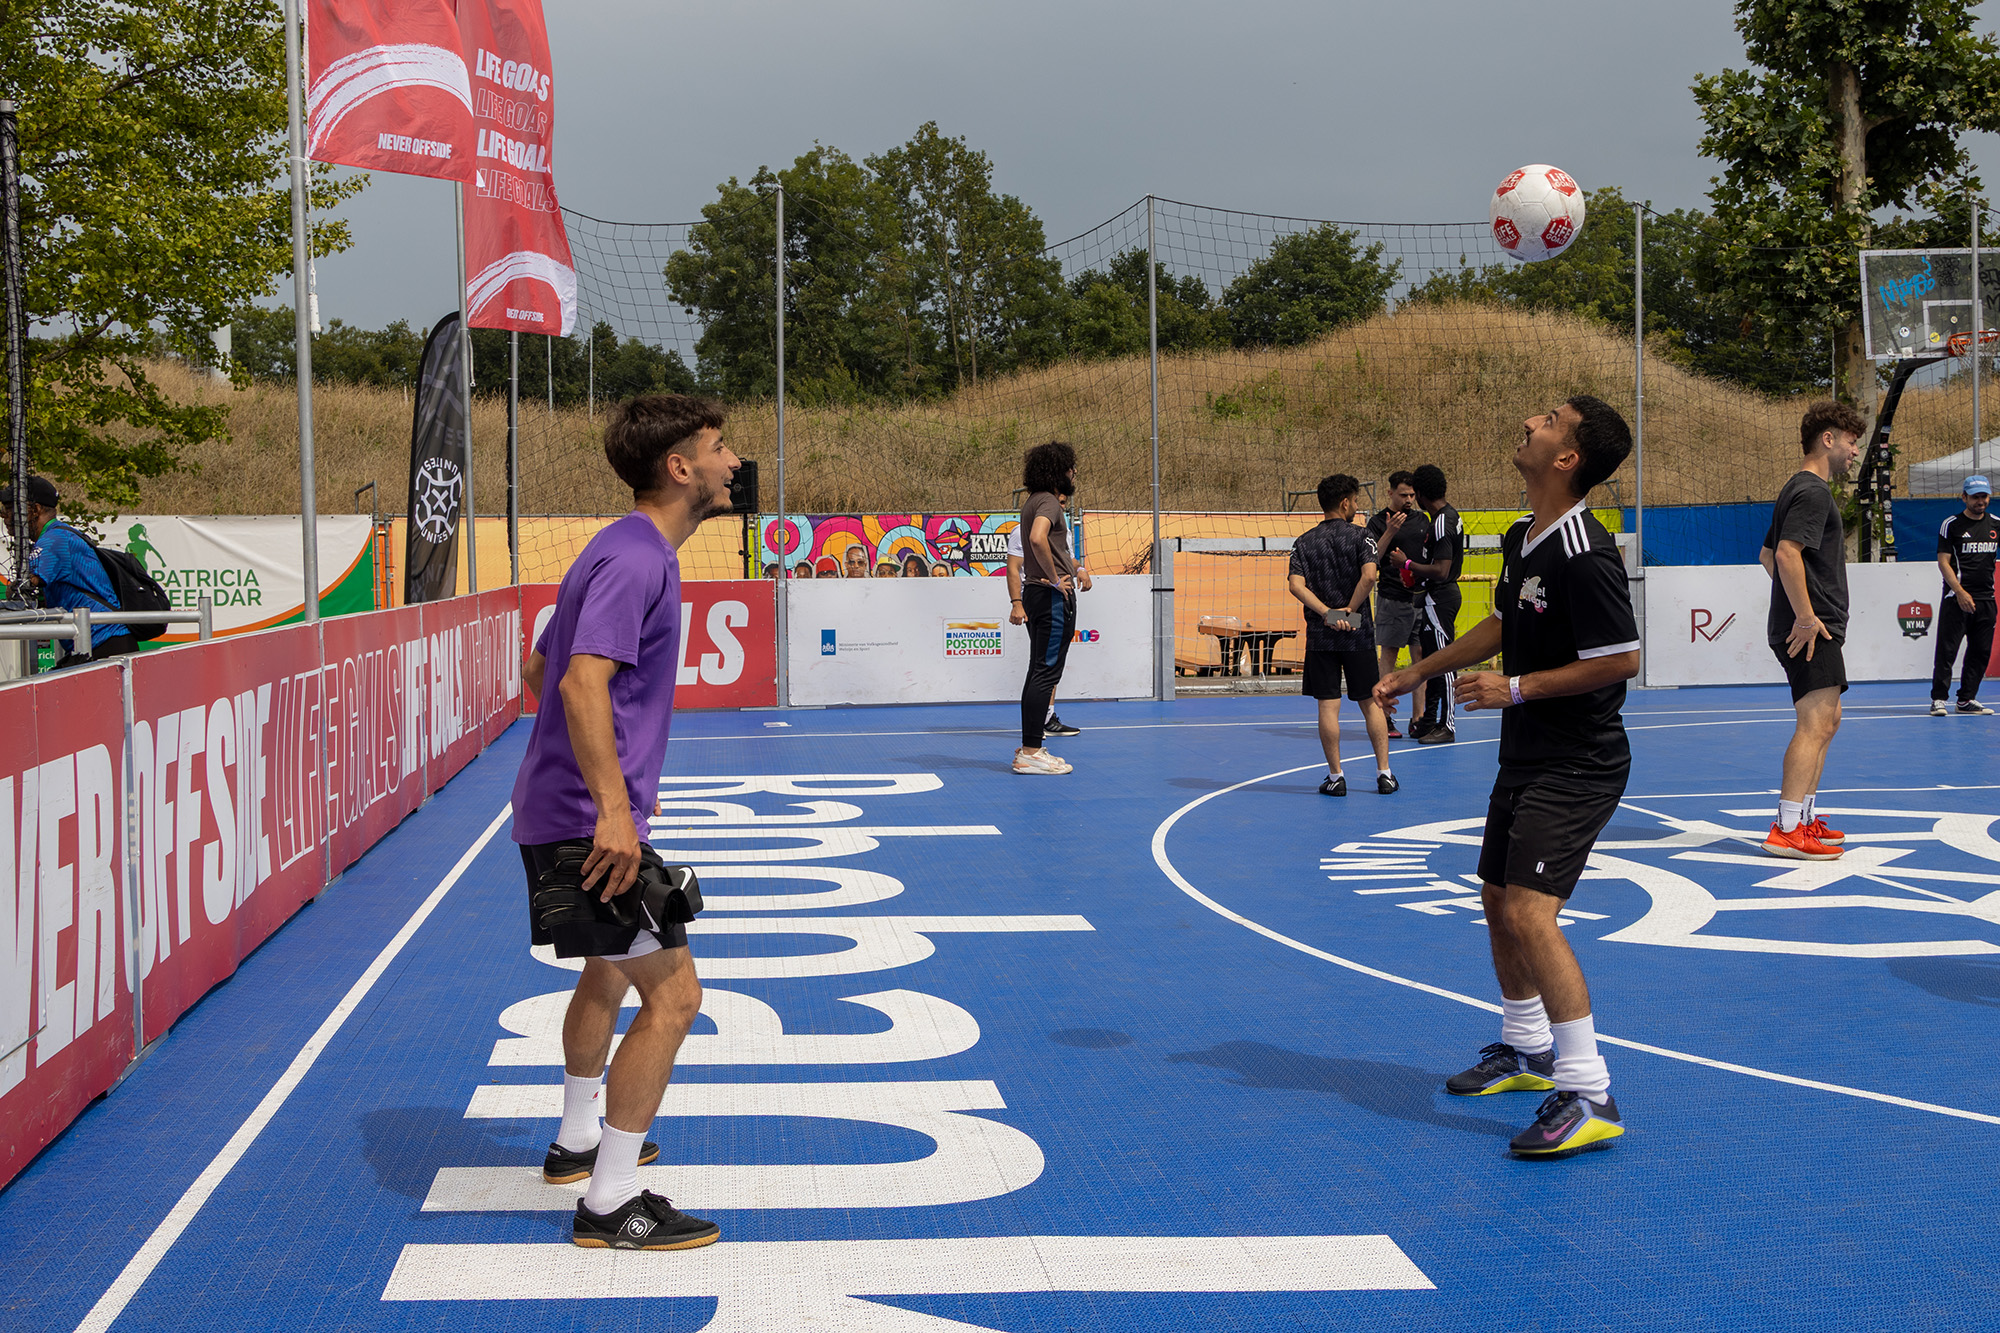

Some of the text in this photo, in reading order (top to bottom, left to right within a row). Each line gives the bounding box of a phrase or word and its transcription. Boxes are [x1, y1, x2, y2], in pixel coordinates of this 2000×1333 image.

[475, 48, 501, 85] LIFE
[475, 88, 504, 124] LIFE
[377, 133, 453, 159] NEVER OFFSIDE
[476, 128, 552, 174] LIFE GOAL
[476, 168, 560, 213] LIFE GOALS
[970, 533, 1011, 553] KWA
[1961, 542, 1977, 553] LIFE
[151, 569, 260, 588] PATRICIA
[163, 588, 263, 607] EEDAR
[946, 638, 1001, 649] POSTCODE
[952, 631, 995, 639] NATIONALE
[0, 743, 115, 1099] VER
[121, 682, 273, 993] OFFSIDE
[275, 663, 339, 871] LIFE
[342, 644, 402, 829] GOALS
[401, 636, 428, 781] LIFE
[430, 625, 463, 760] GOALS
[631, 1221, 643, 1234] 90
